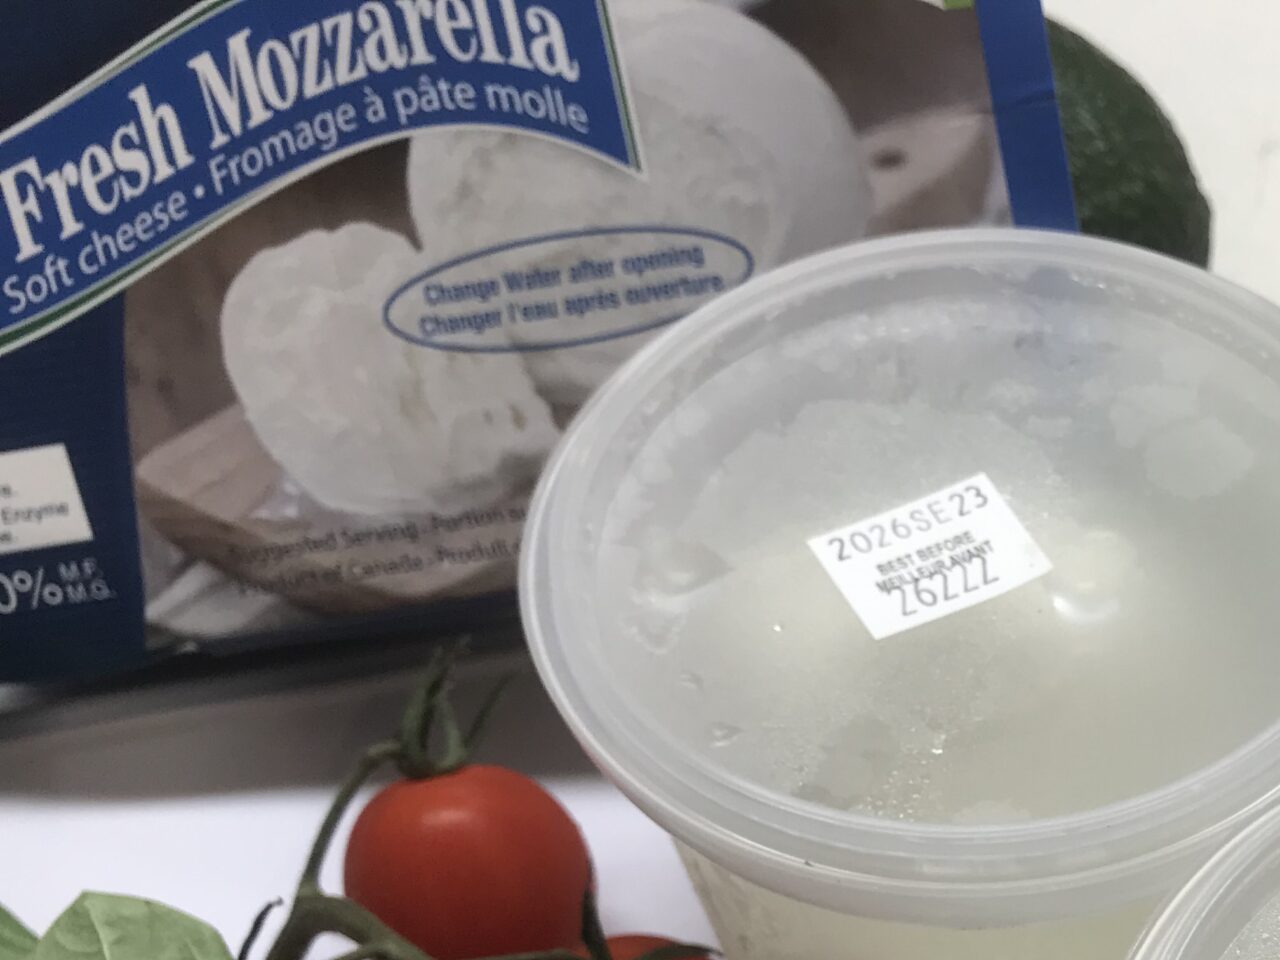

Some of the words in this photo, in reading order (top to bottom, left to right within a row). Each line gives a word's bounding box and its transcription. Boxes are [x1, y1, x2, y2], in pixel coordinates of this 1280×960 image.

[0, 83, 196, 263] Fresh
[187, 0, 580, 150] Mozzarella
[3, 254, 74, 314] Soft
[78, 191, 188, 275] cheese
[207, 102, 358, 195] Fromage
[365, 87, 387, 123] à
[393, 74, 477, 126] pâte
[485, 82, 589, 135] molle
[419, 310, 501, 338] Changer
[507, 301, 558, 323] l'eau
[564, 288, 620, 317] après
[625, 274, 724, 307] ouverture
[423, 279, 498, 307] Change
[502, 267, 562, 292] Water
[568, 258, 616, 284] after
[621, 246, 705, 278] opening
[828, 485, 988, 561] 2026SE23
[875, 553, 915, 577] BEST
[915, 530, 976, 563] BEFORE
[948, 540, 995, 568] AVANT
[886, 554, 999, 617] 26222
